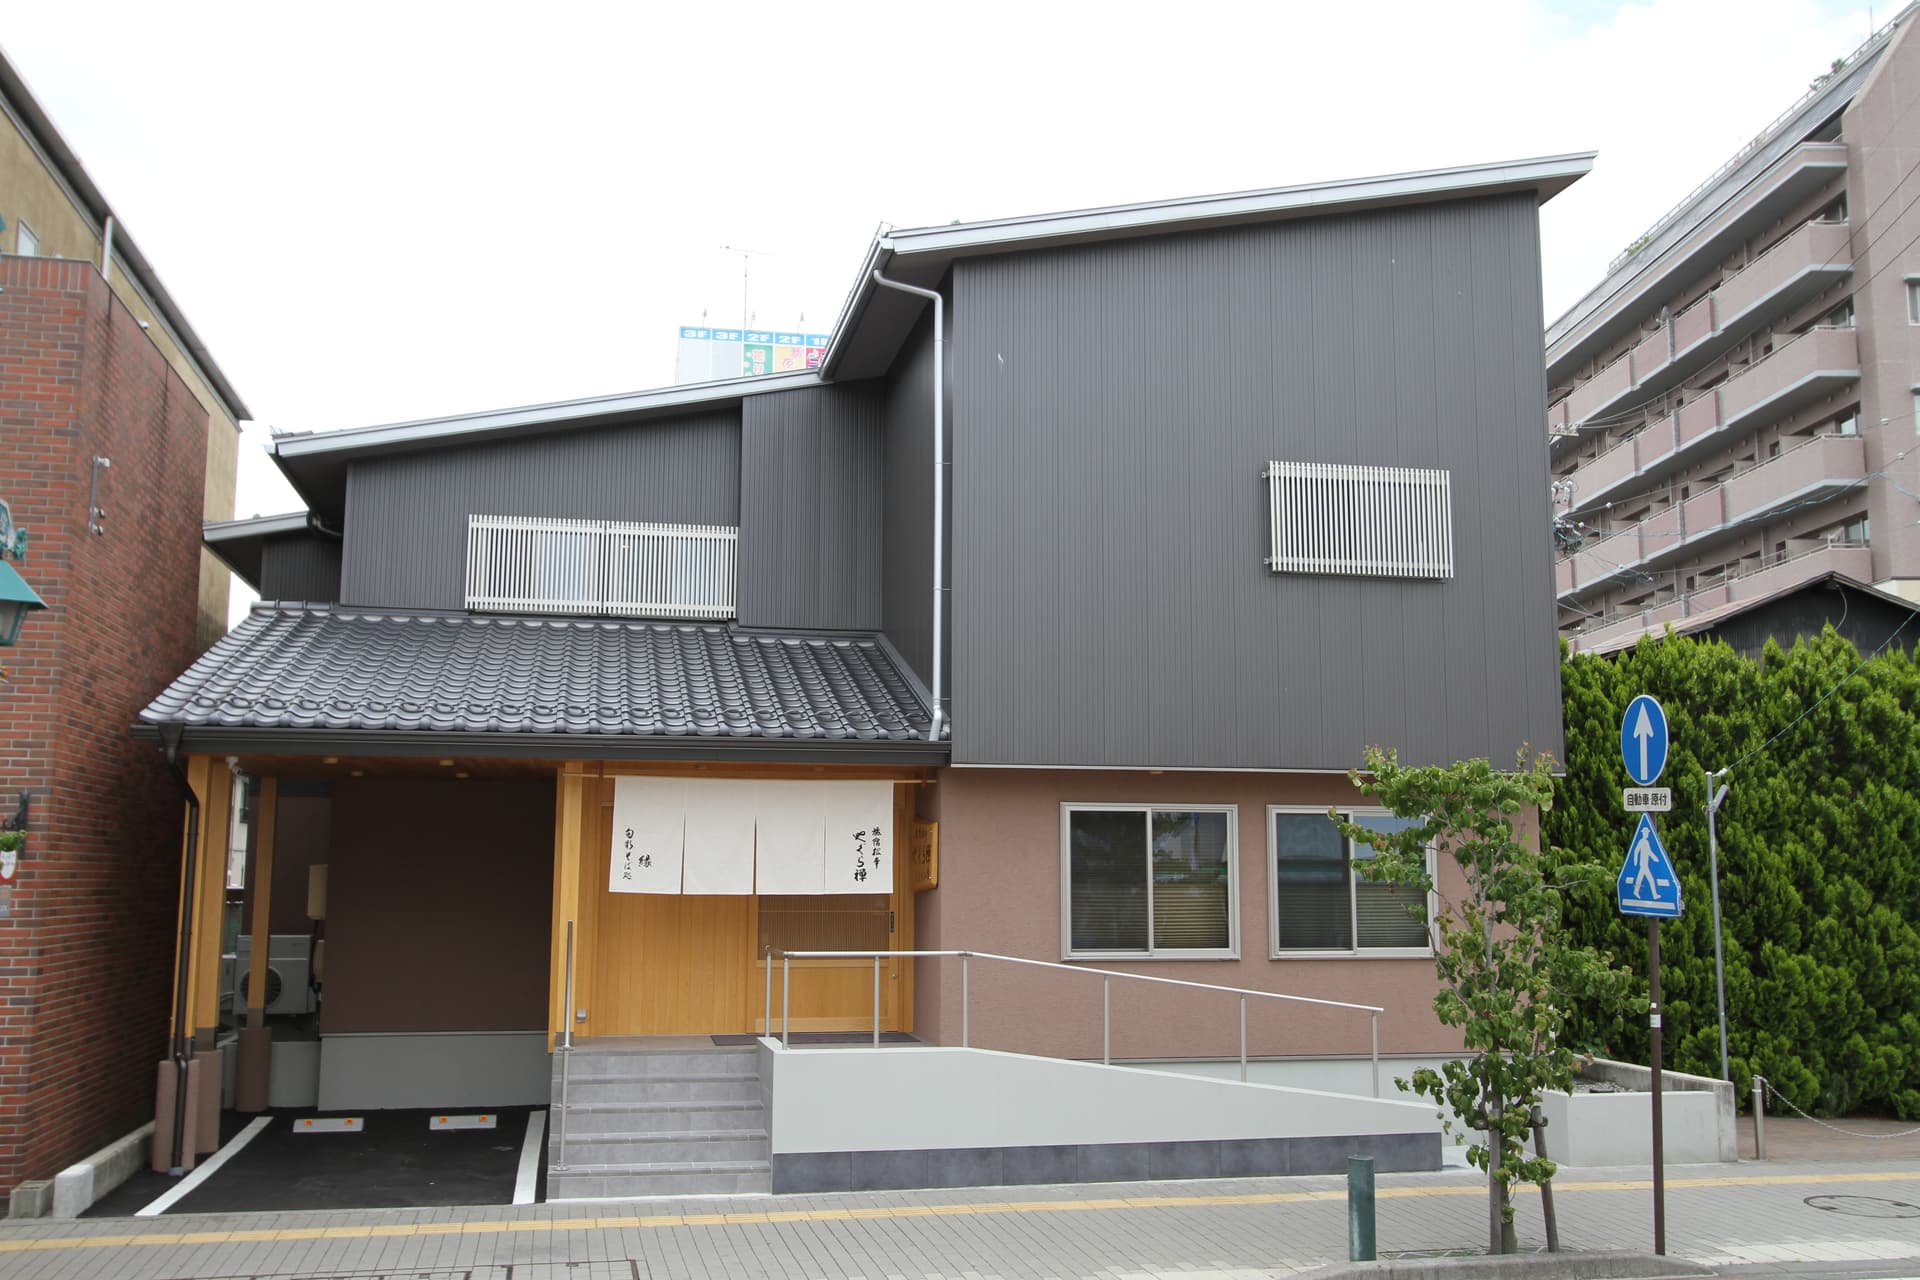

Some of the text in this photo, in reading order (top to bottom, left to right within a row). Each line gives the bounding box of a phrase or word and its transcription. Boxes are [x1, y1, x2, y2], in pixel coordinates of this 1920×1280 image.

[684, 329, 707, 339] 3F
[716, 331, 740, 341] 3F
[747, 333, 770, 342] 2F
[778, 335, 801, 345] 2F
